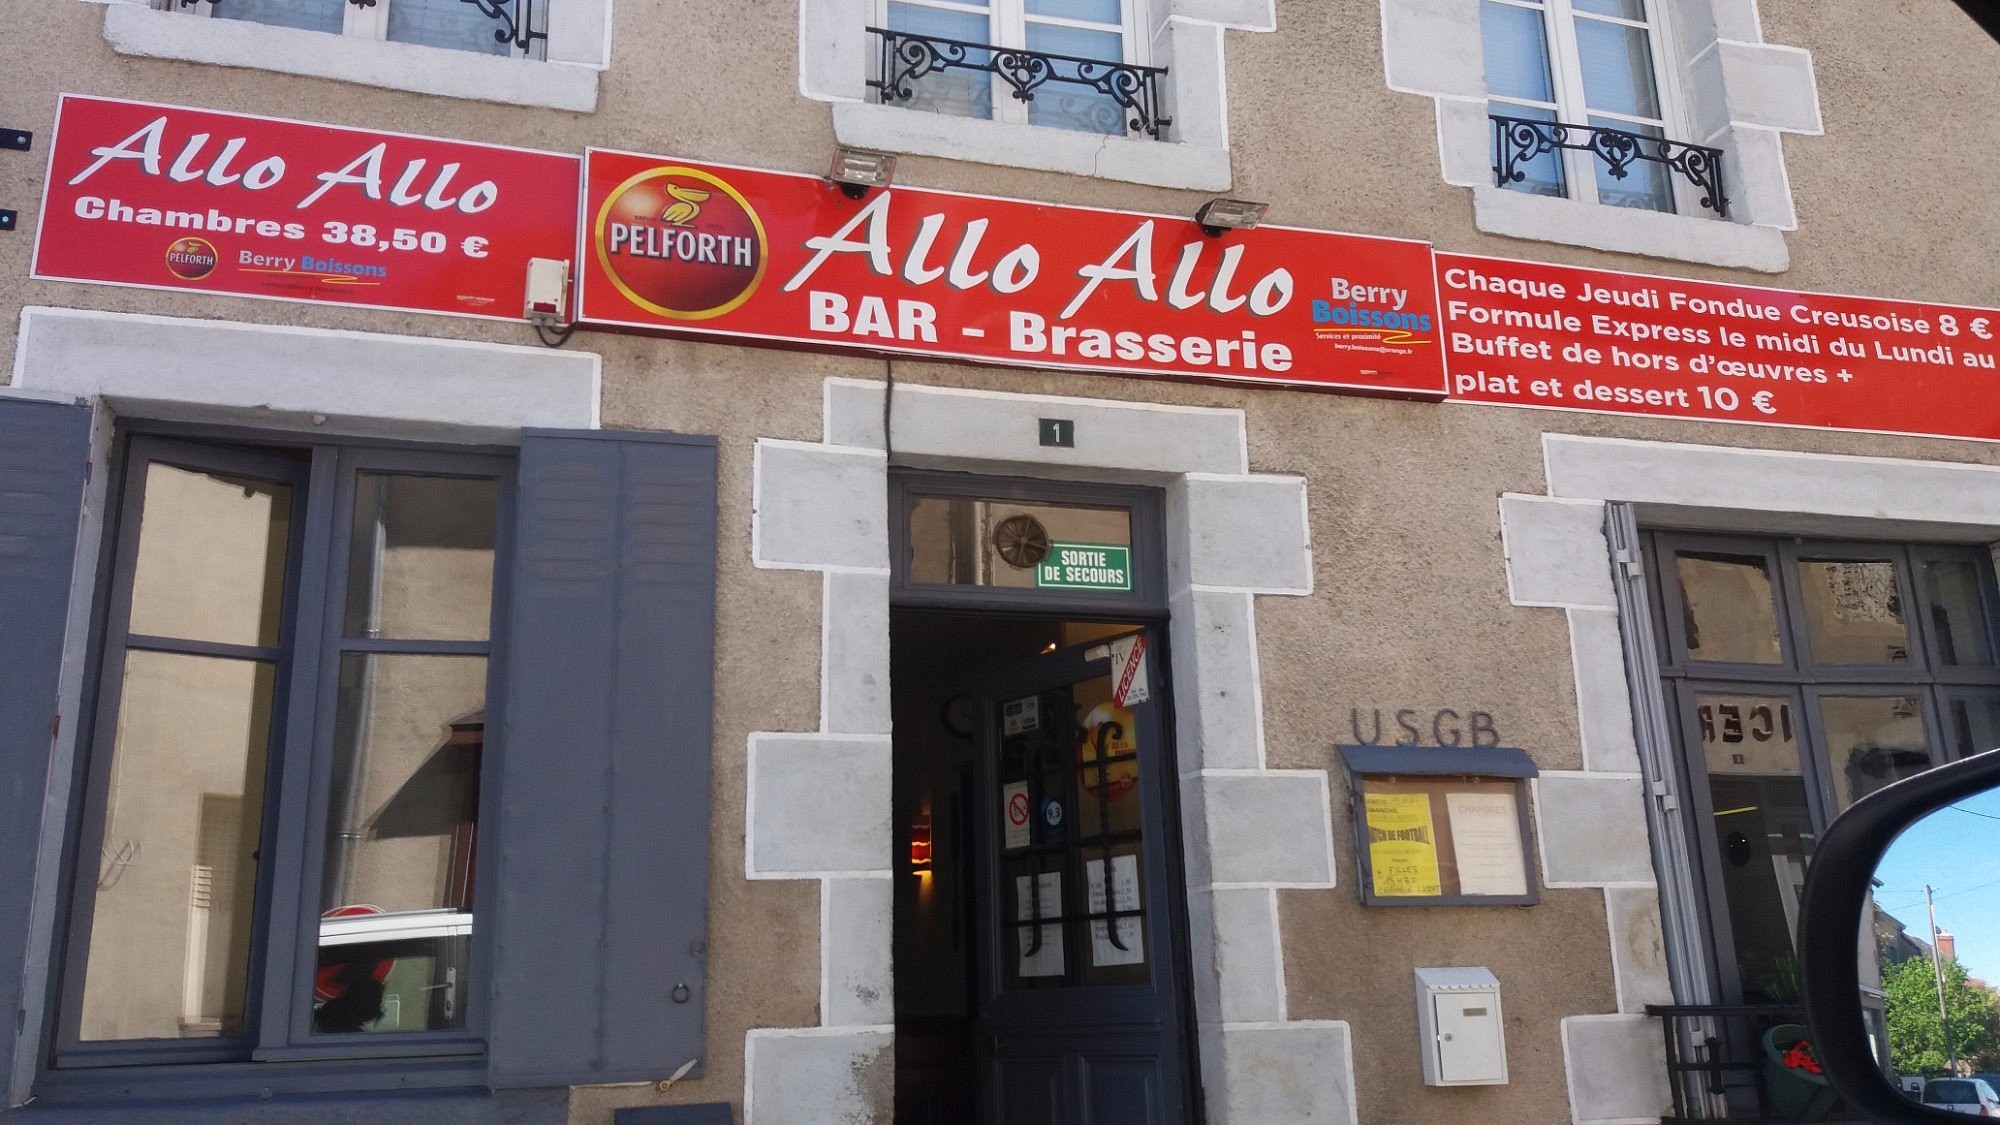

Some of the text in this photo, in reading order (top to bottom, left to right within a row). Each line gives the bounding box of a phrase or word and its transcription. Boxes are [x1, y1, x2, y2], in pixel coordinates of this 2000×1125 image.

[68, 115, 498, 214] Allo Allo
[74, 196, 489, 258] Chambres 38,50 €
[611, 222, 752, 267] PELFORTH
[169, 251, 213, 266] PELFORTH
[239, 250, 387, 278] Berry Boissons
[783, 190, 1294, 320] Allo Allo
[1331, 278, 1406, 311] Berry
[1445, 268, 1993, 340] Chaque Jeudi Fondue Creusoise 8 €
[809, 290, 938, 343] BAR
[1009, 310, 1293, 372] Brasserie
[1312, 300, 1431, 331] Boissons
[1448, 300, 1996, 369] Formule Express le midi du Lundi au
[1451, 332, 1552, 361] Buffet
[1562, 342, 1602, 365] de
[1611, 345, 1680, 371] hors
[1836, 368, 1853, 383] +
[1455, 370, 1777, 414] plat et dessert 10 €
[1053, 423, 1060, 443] 1
[1045, 566, 1124, 584] DE SECOURS
[1062, 551, 1105, 566] SORTIE
[1115, 652, 1125, 664] IV
[1118, 637, 1144, 703] LICENCE
[1352, 708, 1500, 747] USGB
[1388, 830, 1396, 840] DE
[1397, 825, 1430, 845] FOOTBALL
